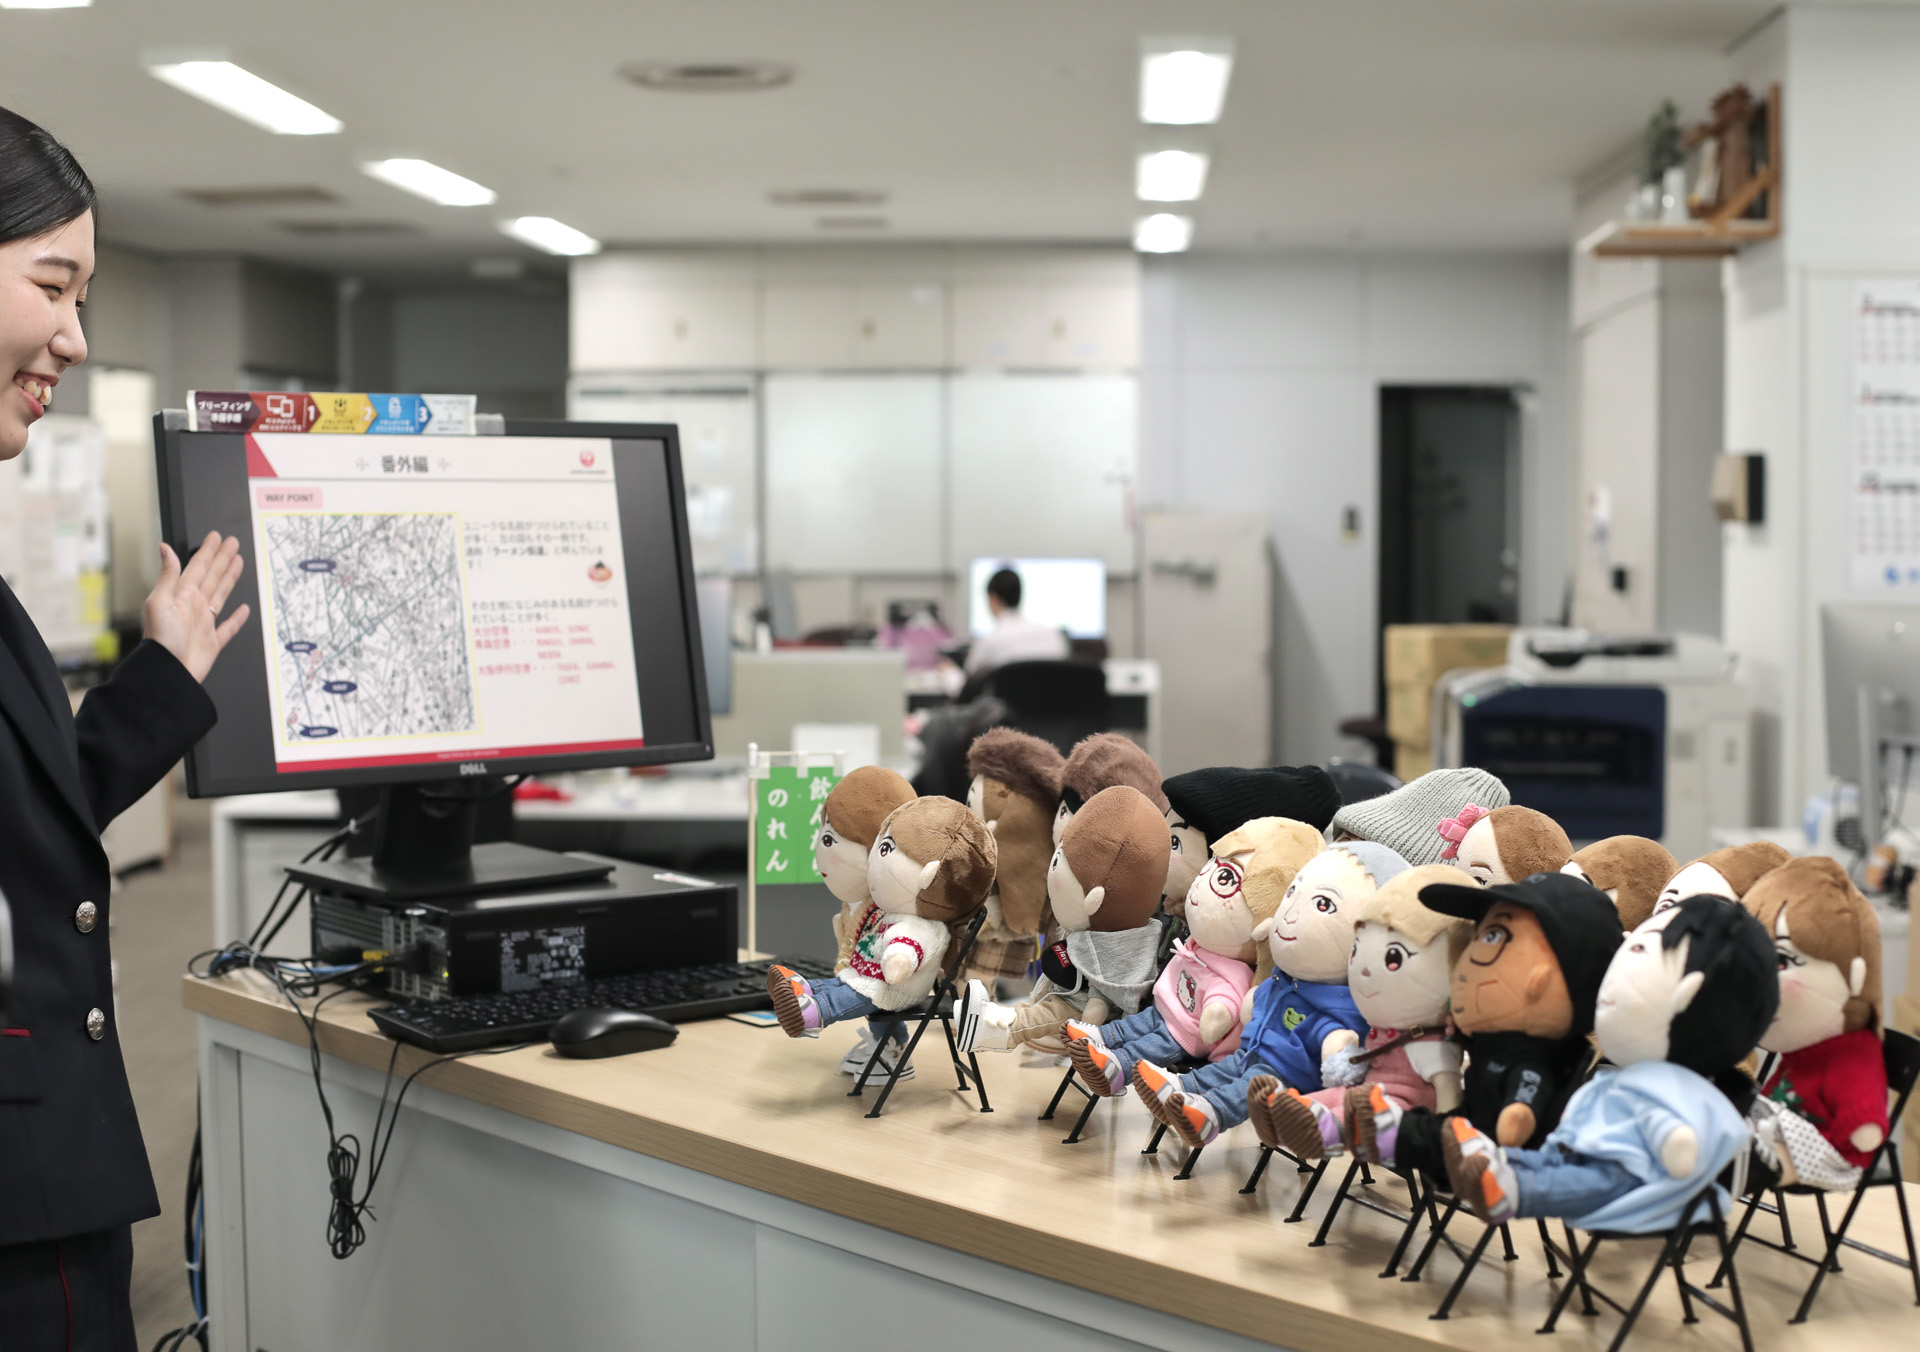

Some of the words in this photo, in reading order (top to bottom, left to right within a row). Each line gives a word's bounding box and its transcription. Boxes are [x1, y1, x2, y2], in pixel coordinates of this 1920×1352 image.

[198, 401, 252, 412] ブリーフィング
[307, 405, 316, 421] 1
[363, 406, 373, 422] 2
[418, 406, 428, 423] 3
[381, 455, 429, 473] 番外編
[265, 493, 284, 503] WAY
[287, 493, 314, 502] POINT
[460, 762, 487, 776] DELL
[765, 788, 789, 872] のれん
